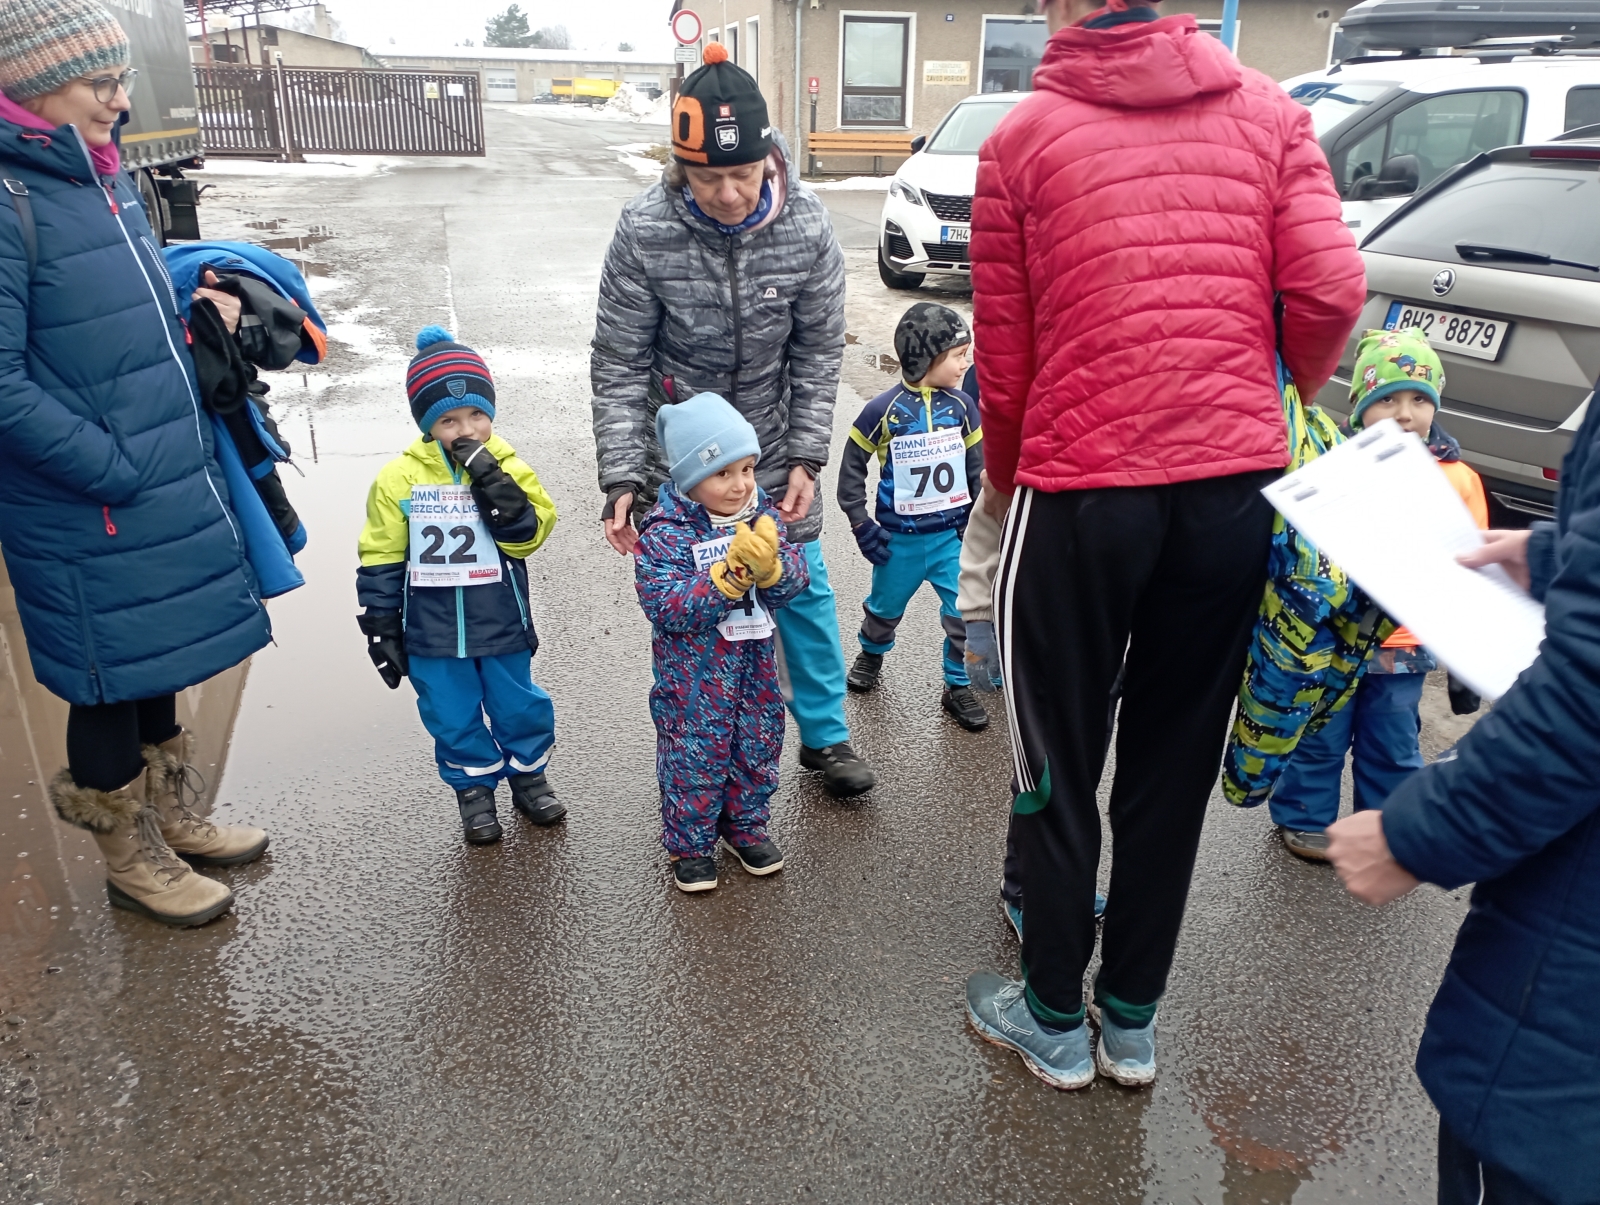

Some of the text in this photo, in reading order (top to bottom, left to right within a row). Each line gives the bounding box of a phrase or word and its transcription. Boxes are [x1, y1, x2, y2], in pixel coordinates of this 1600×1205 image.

[949, 229, 969, 241] 7H4
[1385, 322, 1396, 330] CZ
[1398, 308, 1497, 349] 8H2 8879
[893, 437, 927, 450] ZIMNÍ
[895, 442, 964, 460] BĚŽECKÁ LIGA
[910, 462, 955, 498] 70
[410, 489, 440, 502] ZIMNÍ
[462, 504, 480, 514] LIG
[420, 525, 477, 564] 22
